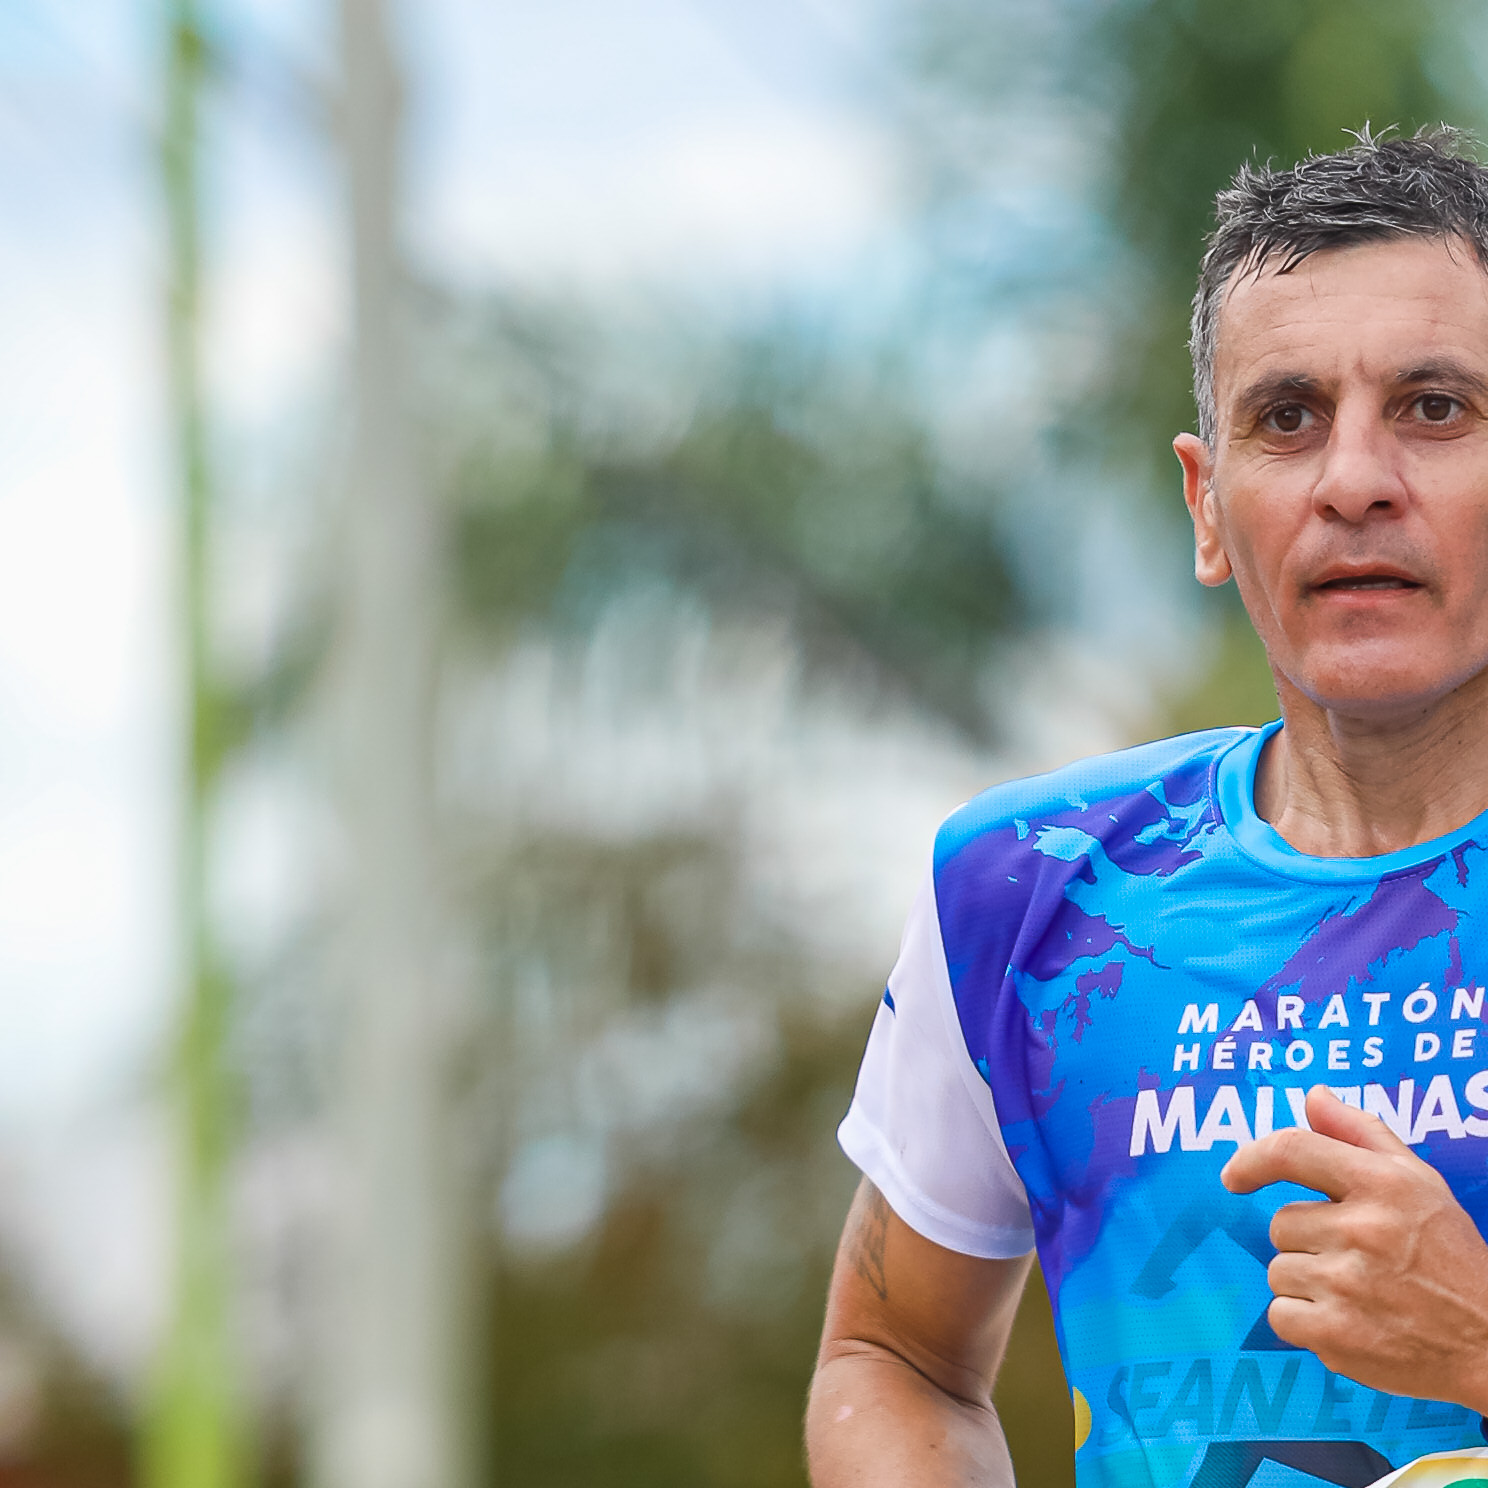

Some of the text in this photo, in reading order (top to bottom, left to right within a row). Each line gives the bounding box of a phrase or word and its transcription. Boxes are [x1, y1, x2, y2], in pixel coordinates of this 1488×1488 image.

[1177, 981, 1486, 1034] MARATÓN
[1172, 1028, 1477, 1072] HÉROES DE
